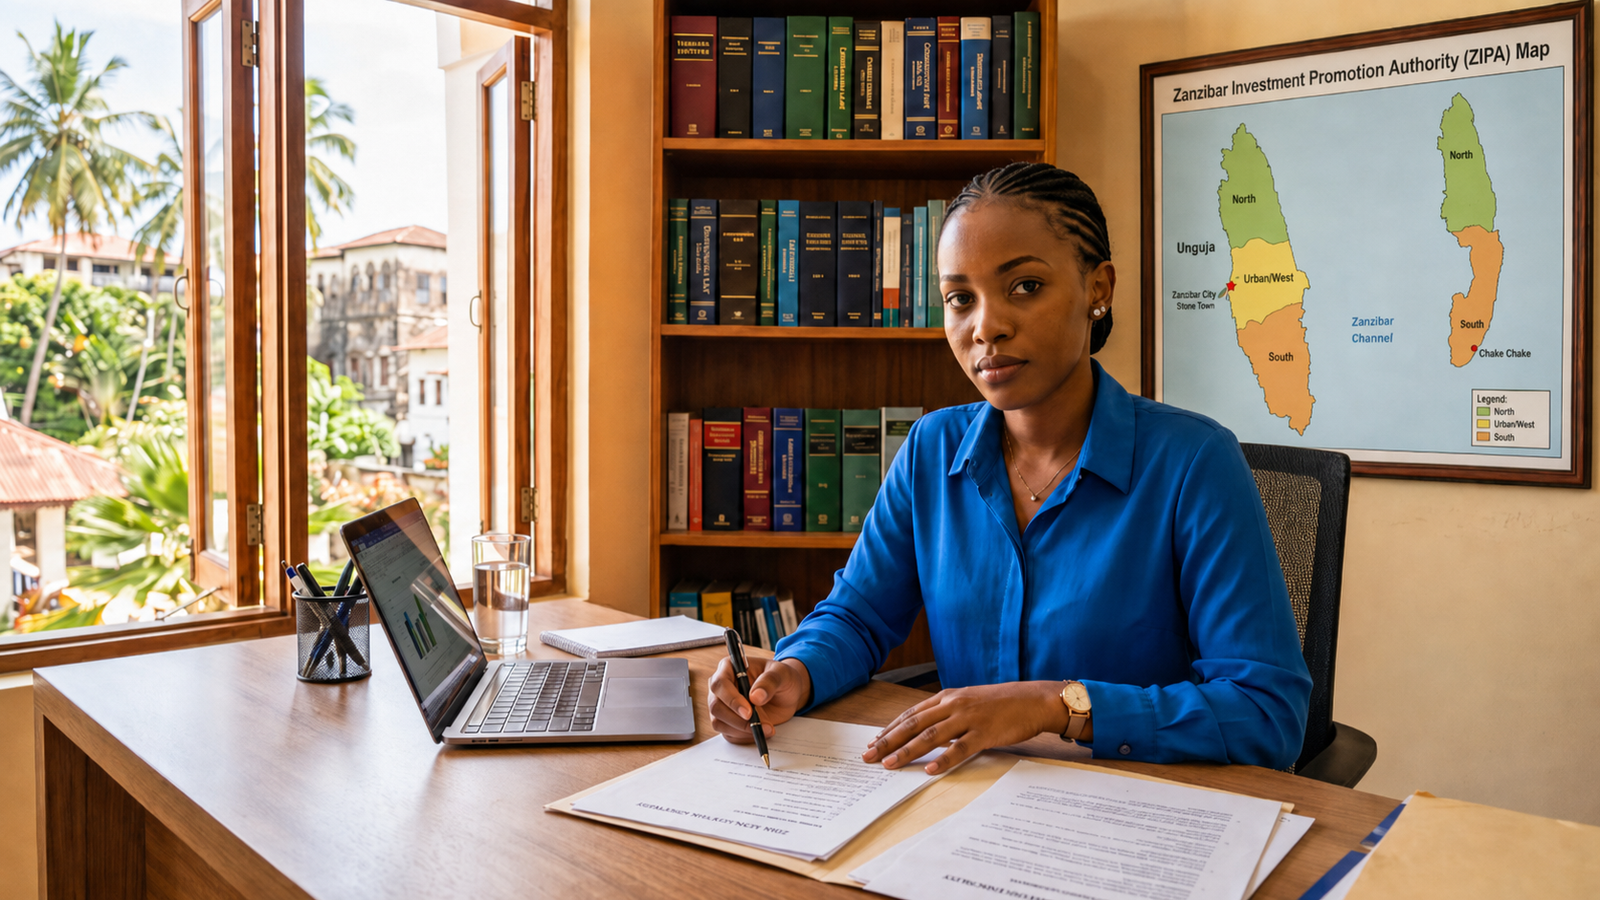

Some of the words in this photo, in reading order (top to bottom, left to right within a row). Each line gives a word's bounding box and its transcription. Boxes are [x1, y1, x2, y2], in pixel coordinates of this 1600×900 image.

[1173, 84, 1228, 103] Zanzibar
[1232, 72, 1306, 96] Investment
[1309, 63, 1384, 86] Promotion
[1388, 53, 1459, 72] Authority
[1464, 44, 1510, 70] (ZIPA)
[1516, 41, 1550, 61] Map
[1449, 150, 1473, 160] North
[1232, 193, 1256, 204] North
[1177, 241, 1215, 256] Unguja
[1243, 272, 1294, 284] Urban/West
[1202, 289, 1217, 301] City
[1176, 301, 1195, 310] Stone
[1197, 301, 1215, 310] Town
[1351, 316, 1395, 327] Zanzibar
[1460, 319, 1485, 329] South
[1351, 332, 1393, 343] Channel
[1268, 351, 1294, 362] South
[1479, 348, 1504, 358] Chake
[1505, 348, 1531, 358] Chake
[1477, 394, 1507, 405] Legend:
[1494, 407, 1515, 416] North
[1494, 432, 1515, 442] South
